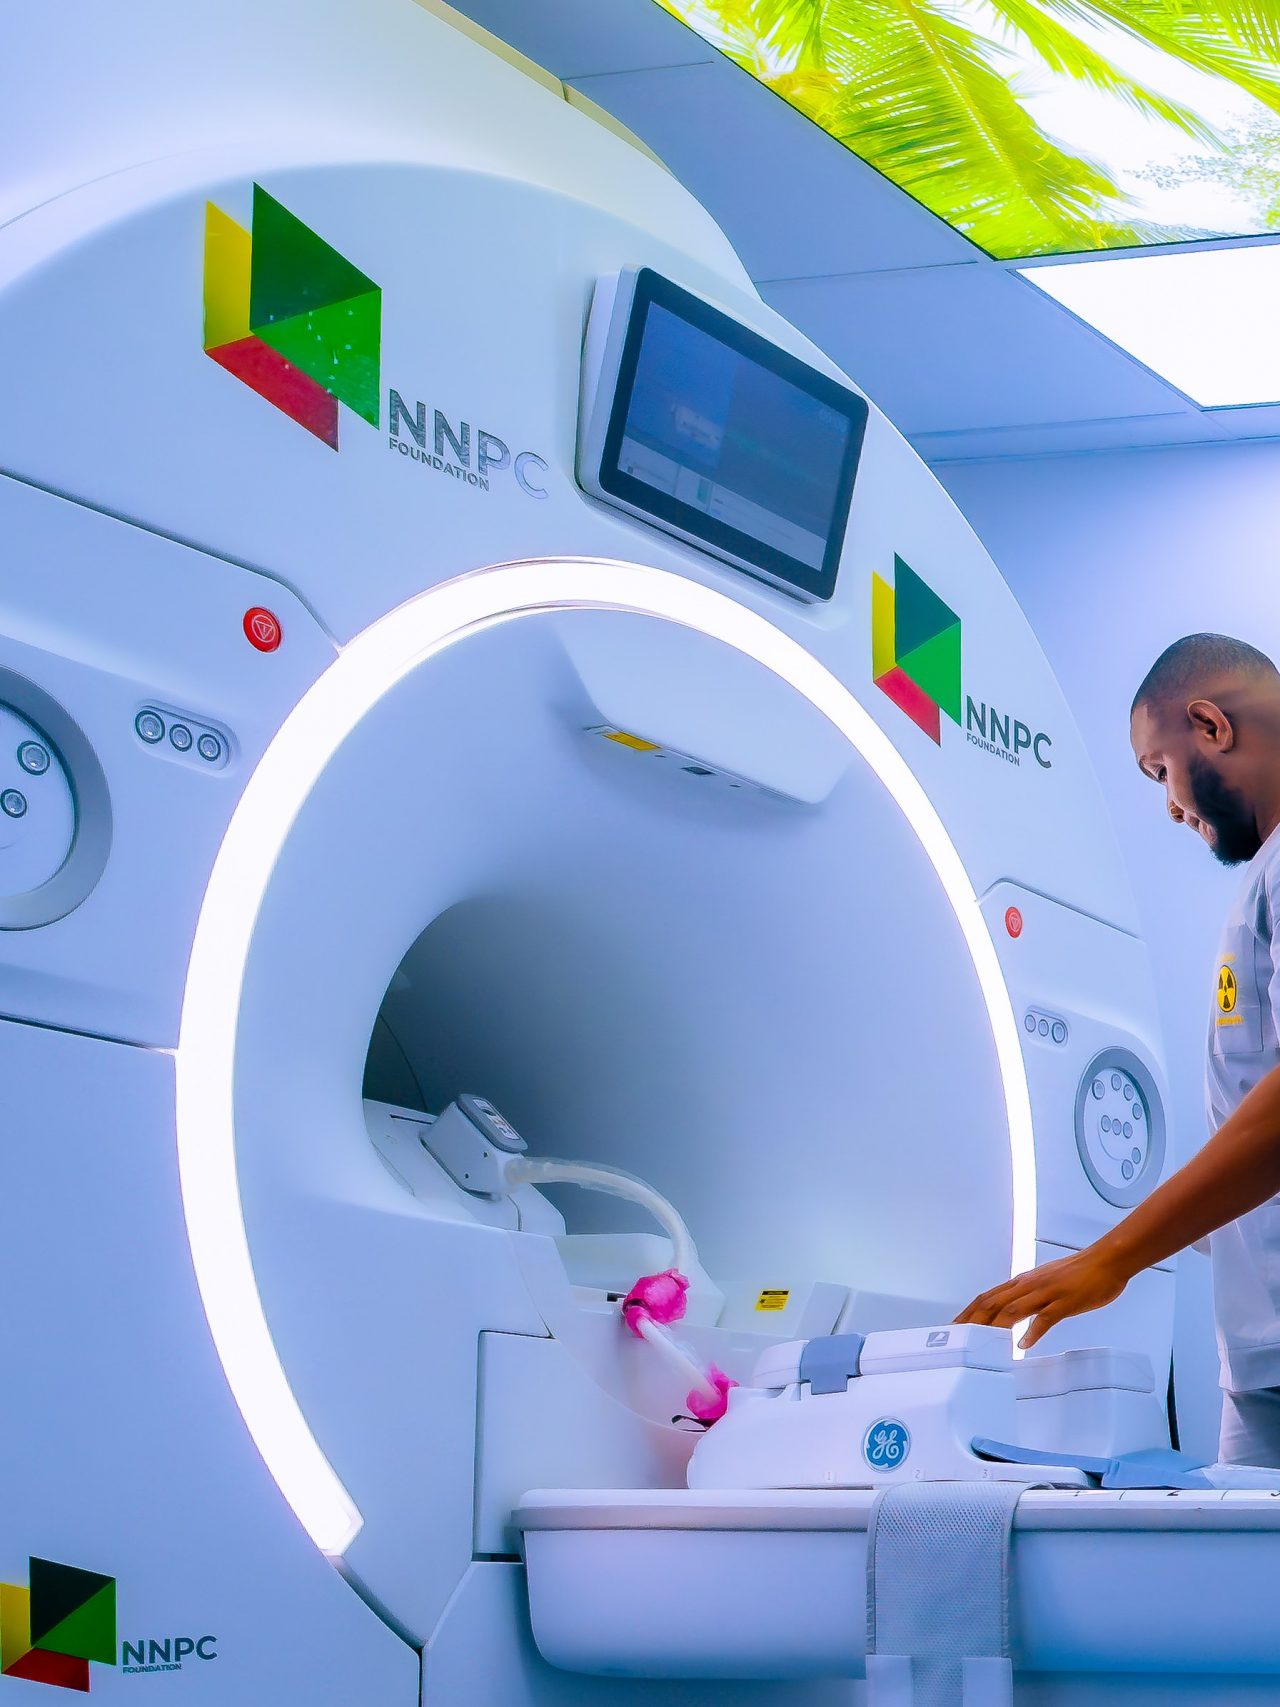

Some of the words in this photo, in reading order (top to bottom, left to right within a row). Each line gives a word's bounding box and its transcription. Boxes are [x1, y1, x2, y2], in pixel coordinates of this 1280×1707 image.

[389, 388, 549, 500] NNPC
[389, 437, 490, 492] FOUNDATION
[966, 694, 1052, 769] NNPC
[966, 732, 1020, 767] FOUNDATION
[872, 1429, 900, 1460] GE
[122, 1635, 218, 1666] NNPC
[122, 1663, 182, 1674] FOUNDATION
